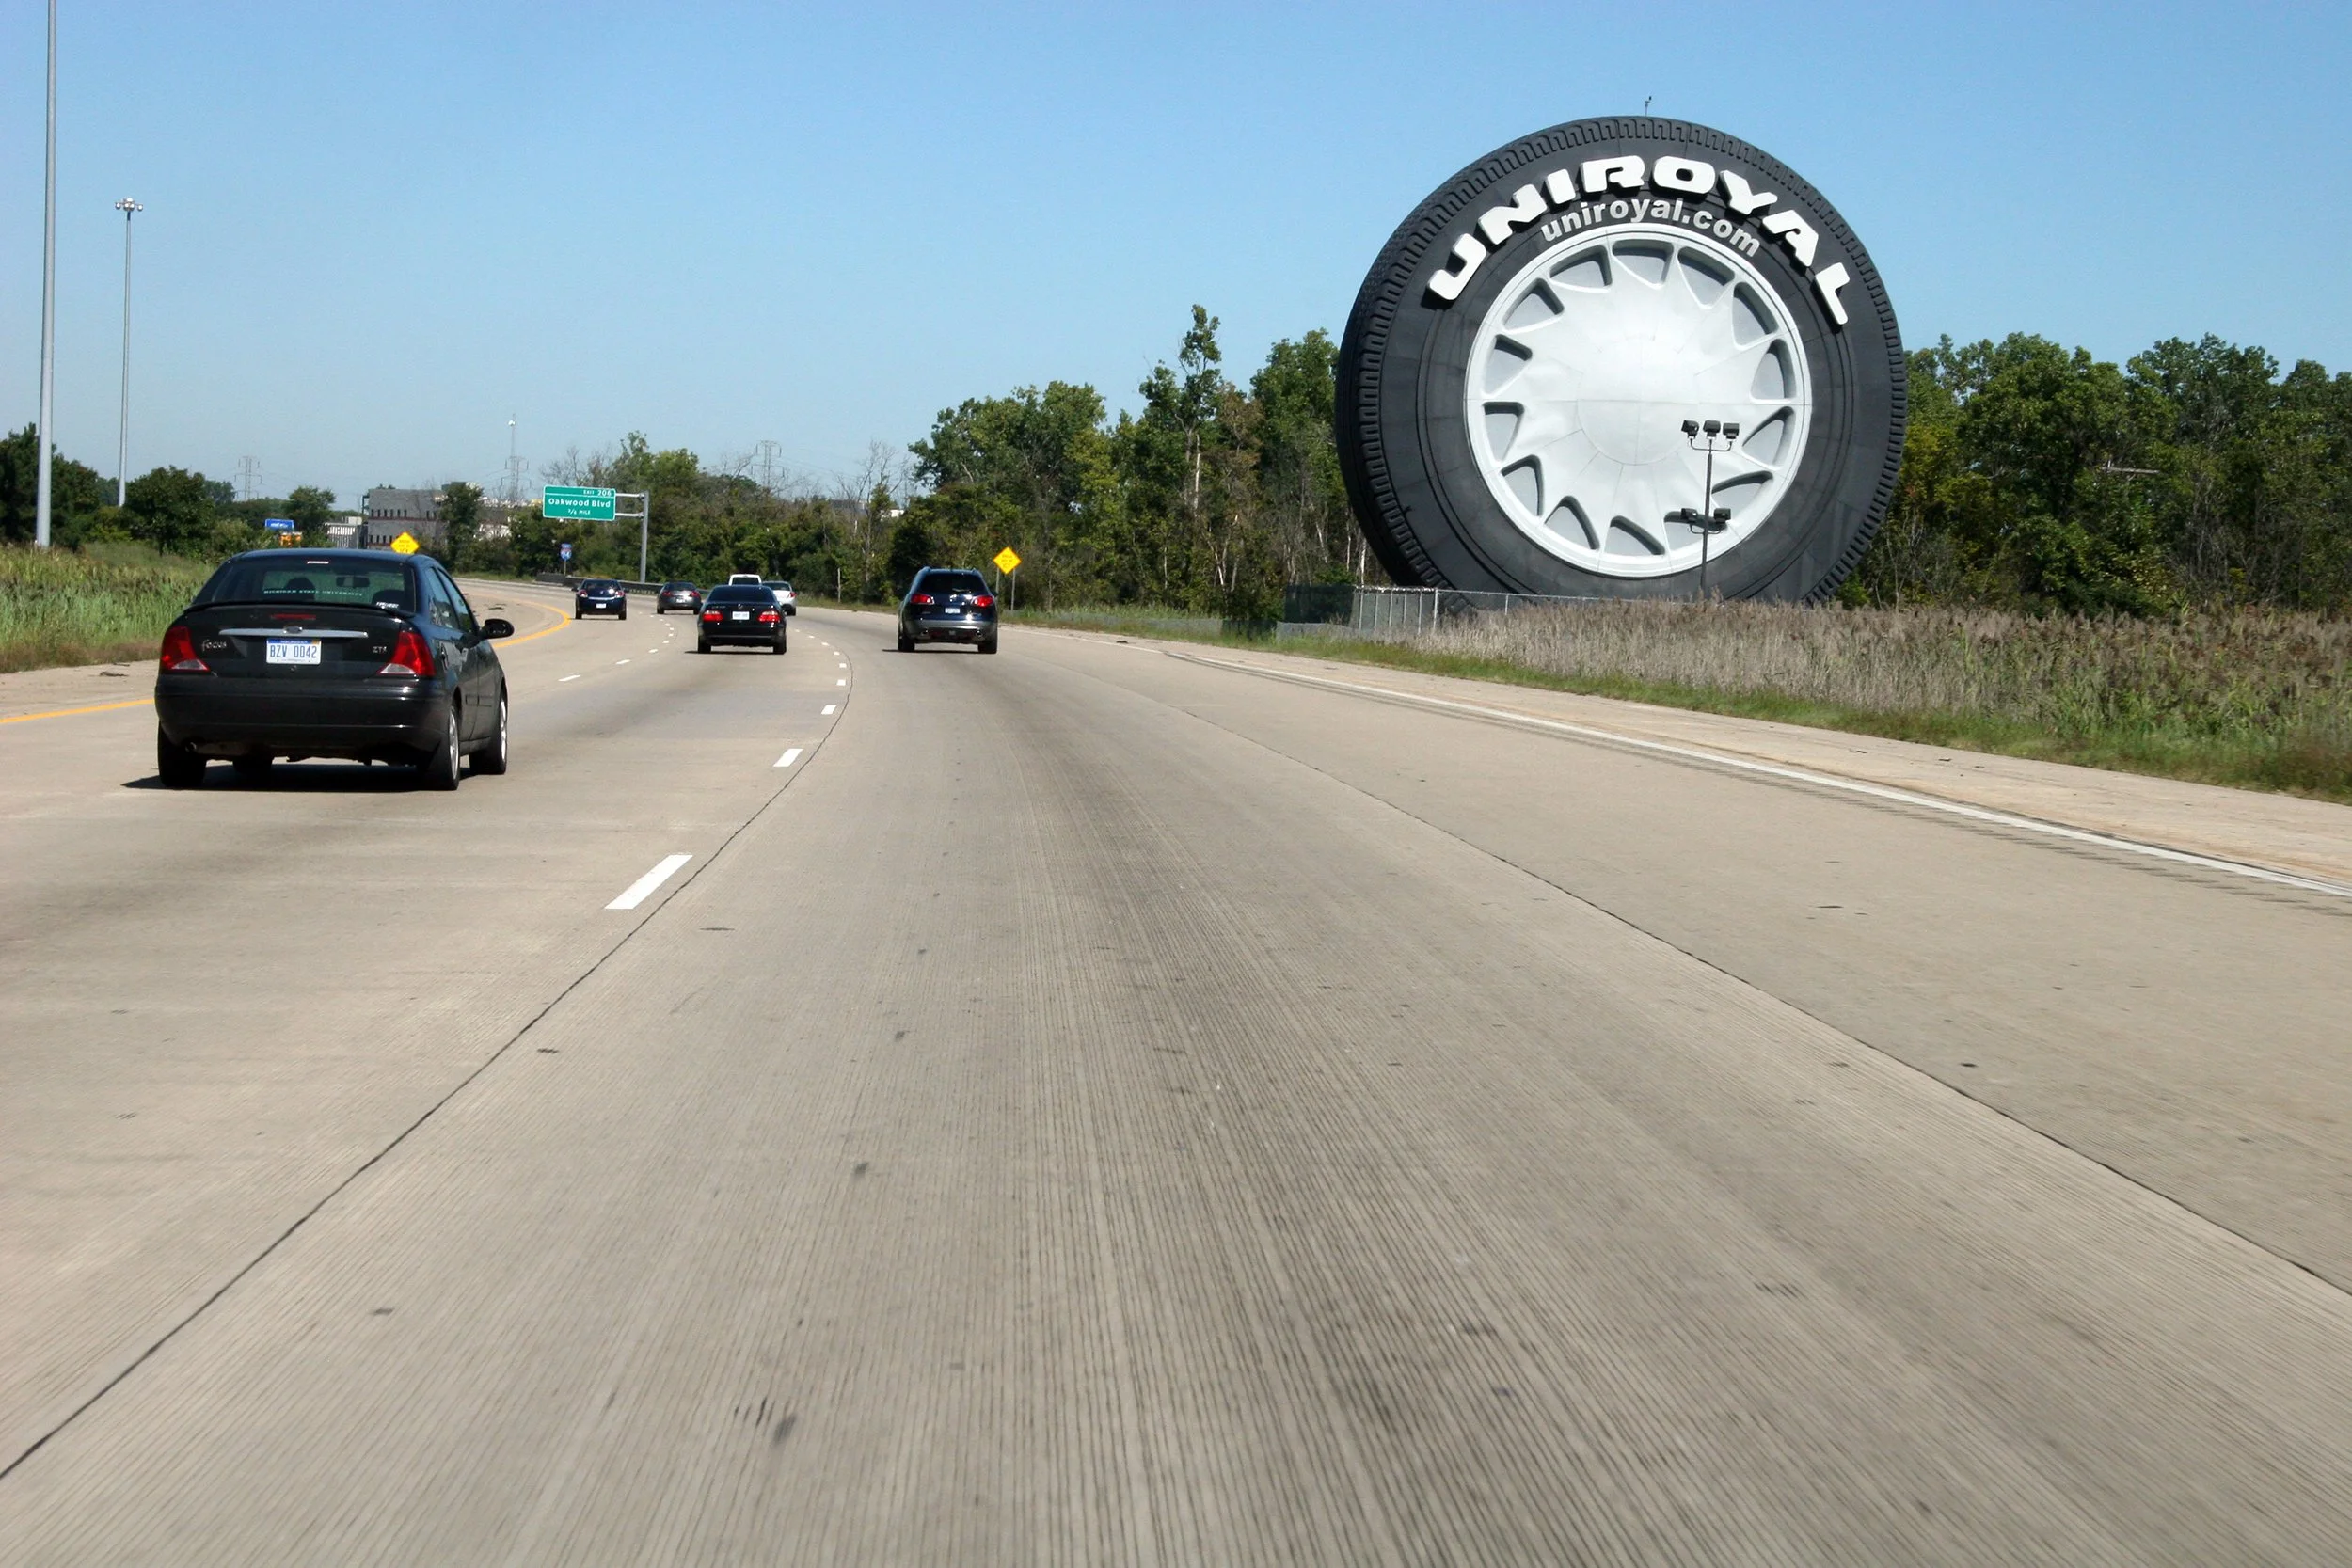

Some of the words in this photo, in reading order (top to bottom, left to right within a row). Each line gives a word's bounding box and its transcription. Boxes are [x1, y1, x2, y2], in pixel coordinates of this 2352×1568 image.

[1427, 154, 1851, 325] UNIROYAL
[1541, 198, 1761, 258] uniroyal.com
[548, 498, 589, 507] Oakwood
[270, 644, 287, 658] BZV
[294, 645, 317, 658] 0042
